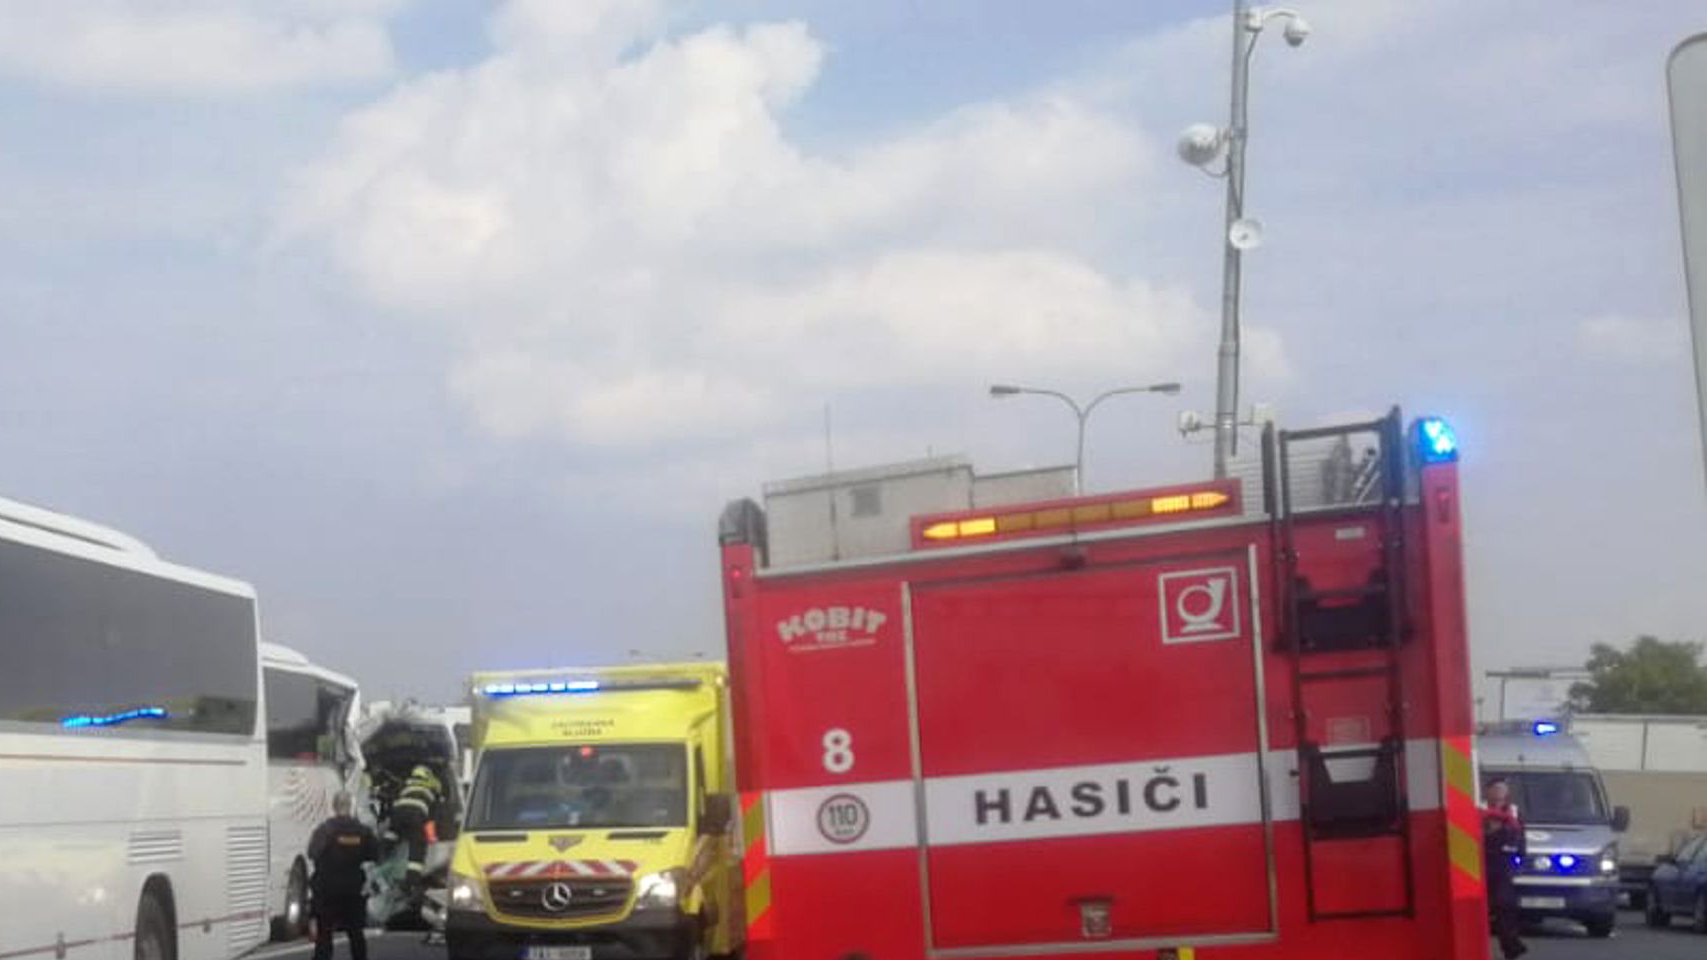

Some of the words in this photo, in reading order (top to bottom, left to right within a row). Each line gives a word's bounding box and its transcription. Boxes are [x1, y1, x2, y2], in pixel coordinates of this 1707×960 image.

[776, 606, 887, 642] KOBIT
[823, 728, 855, 774] 8
[828, 803, 858, 826] 110
[974, 766, 1208, 825] HASIČI
